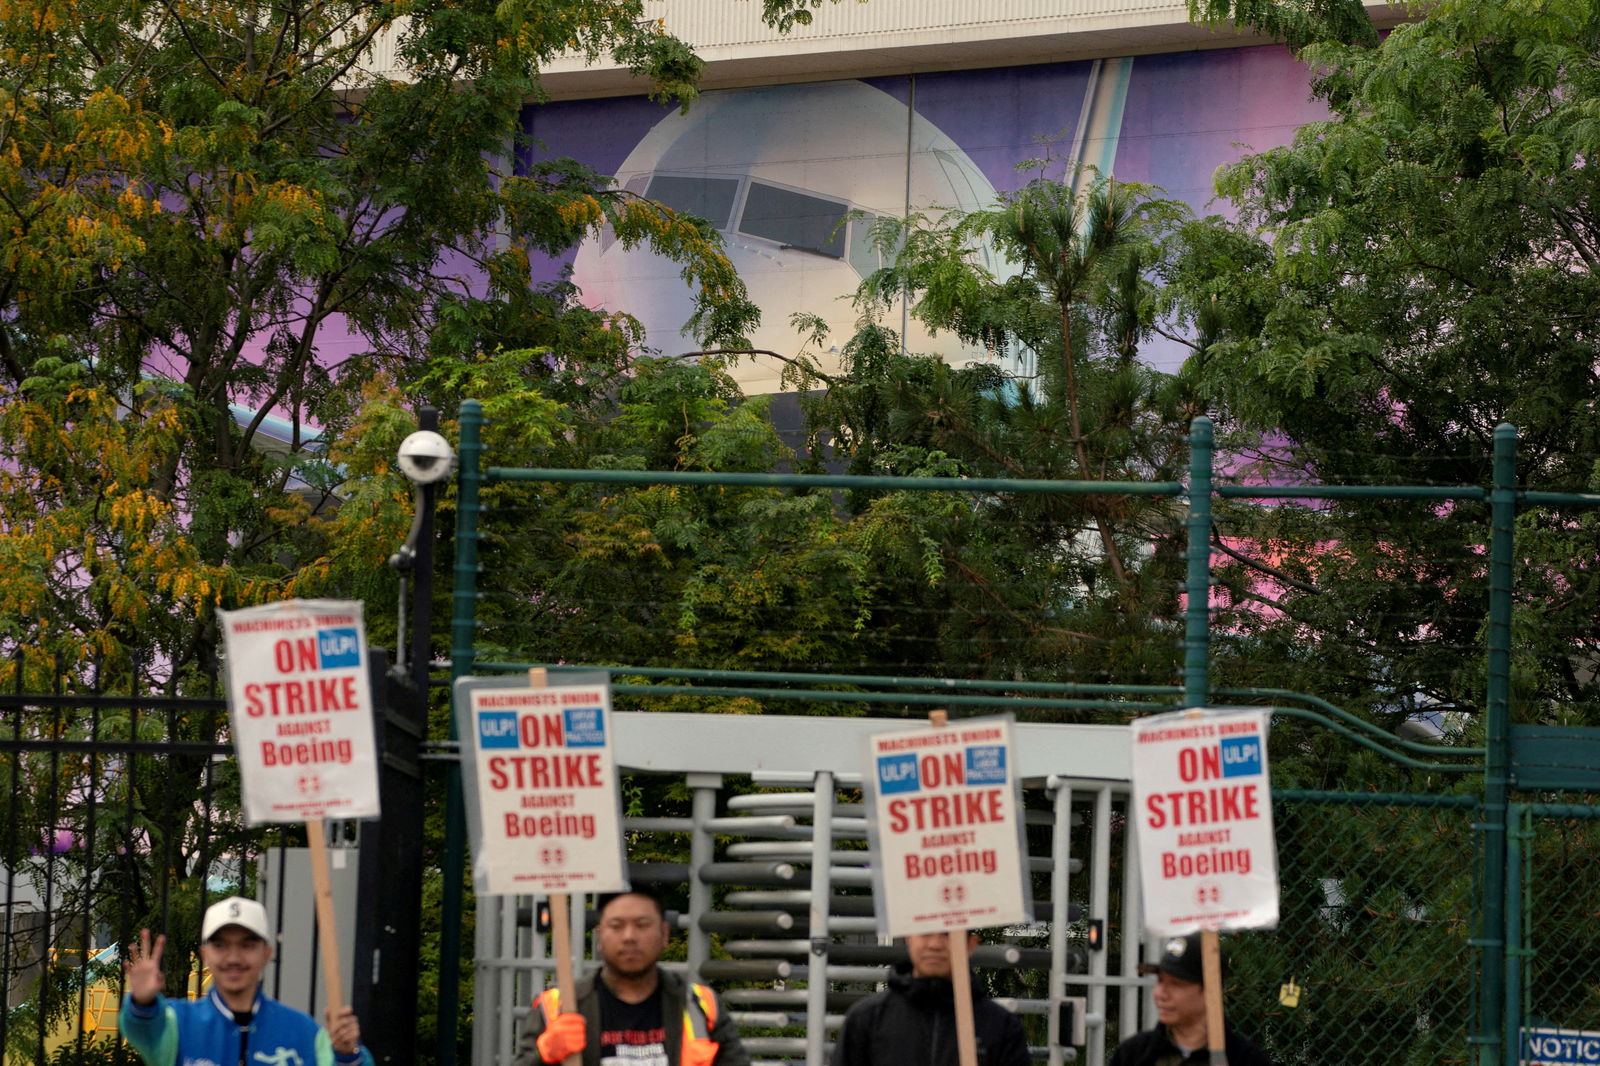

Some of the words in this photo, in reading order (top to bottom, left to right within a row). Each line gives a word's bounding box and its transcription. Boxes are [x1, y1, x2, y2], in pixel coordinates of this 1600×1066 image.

[274, 637, 319, 673] ON
[321, 636, 357, 656] ULP!
[244, 677, 359, 718] STRIKE
[478, 694, 557, 707] MACHINISTS
[561, 692, 601, 705] UNION
[276, 719, 330, 737] AGAINST
[480, 718, 516, 737] ULP!
[520, 714, 564, 748] ON
[877, 733, 959, 752] MACHINISTS
[961, 729, 1001, 743] UNION
[1137, 723, 1215, 743] MACHINISTS
[1218, 721, 1258, 736] UNION
[261, 737, 353, 767] Boeing
[1178, 746, 1221, 783] ON
[1223, 745, 1258, 764] ULP!
[488, 754, 604, 790] STRIKE
[880, 762, 917, 782] ULP!
[921, 752, 966, 789] ON
[520, 794, 575, 808] AGAINST
[888, 790, 1005, 833] STRIKE
[1146, 786, 1259, 829] STRIKE
[505, 811, 596, 839] Boeing
[1178, 830, 1231, 848] AGAINST
[921, 831, 976, 849] AGAINST
[905, 849, 998, 879] Boeing
[1162, 848, 1252, 879] Boeing
